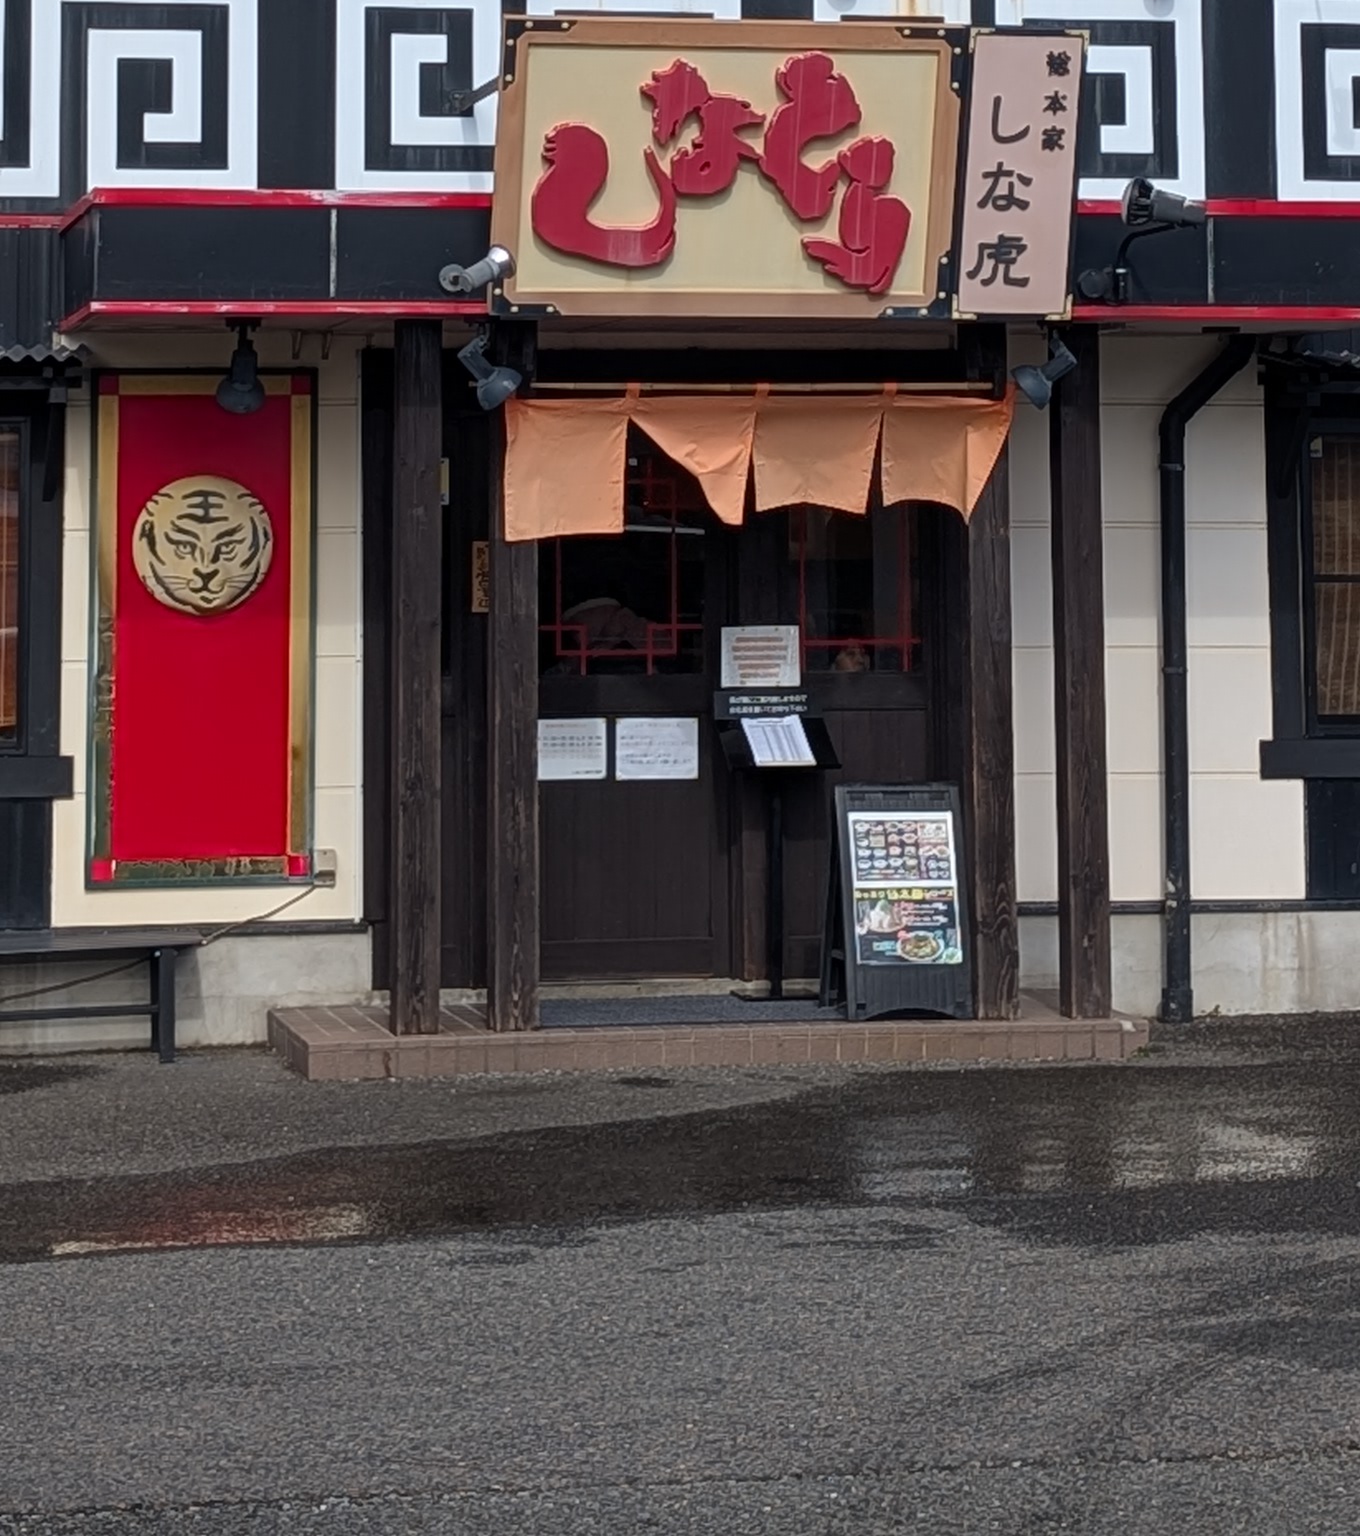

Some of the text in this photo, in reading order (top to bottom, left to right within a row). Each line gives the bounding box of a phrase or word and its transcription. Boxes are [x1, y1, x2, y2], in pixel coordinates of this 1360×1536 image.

[1041, 50, 1072, 152] 総本家
[965, 94, 1034, 289] しな虎
